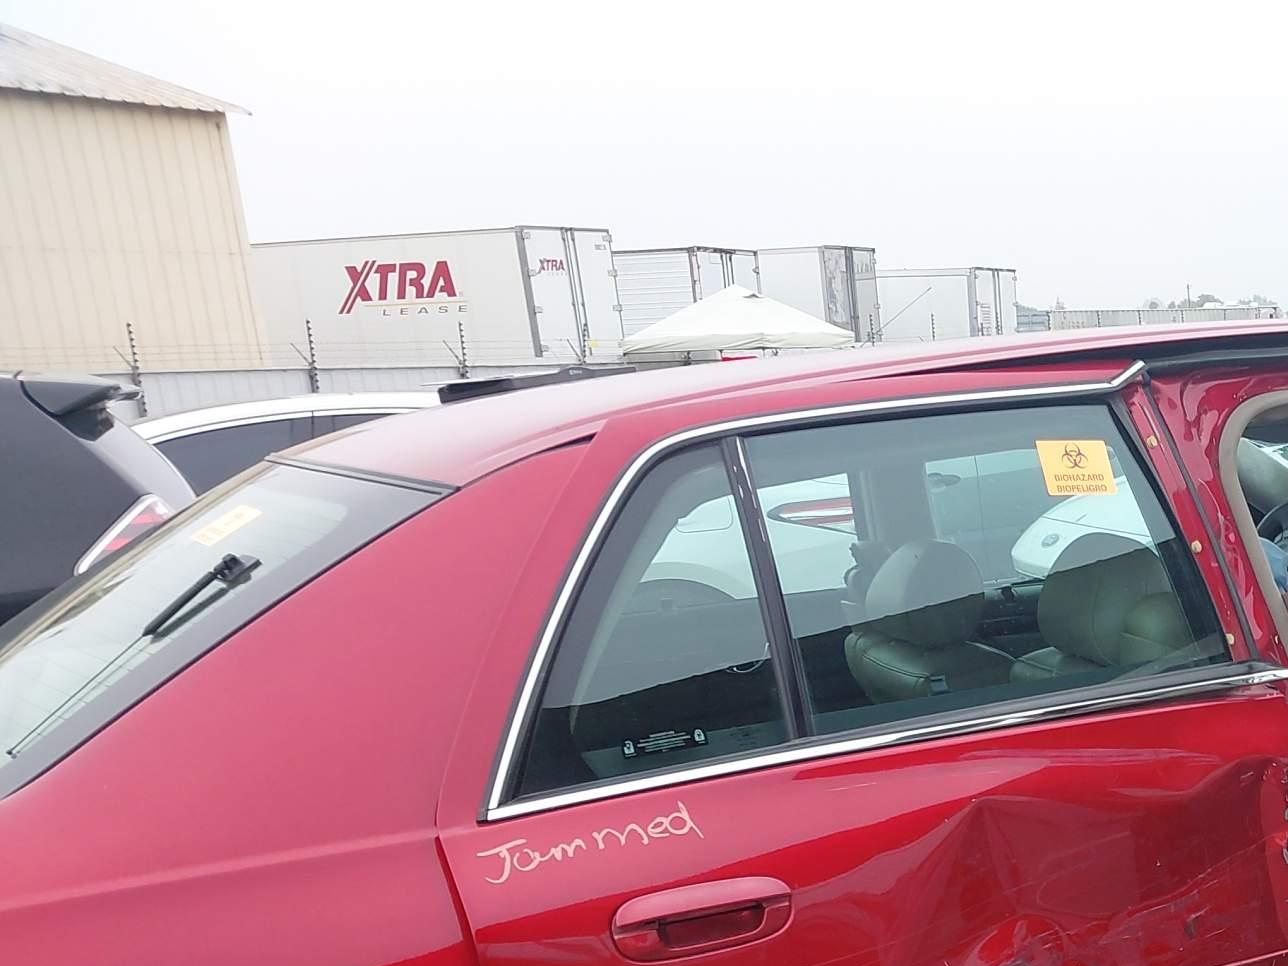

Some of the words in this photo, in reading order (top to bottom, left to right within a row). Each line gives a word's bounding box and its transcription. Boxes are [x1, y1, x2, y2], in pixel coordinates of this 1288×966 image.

[538, 258, 565, 274] XTRA
[338, 260, 457, 314] XTRA
[382, 305, 468, 317] LEASE
[1054, 473, 1104, 482] BIOHAZARD
[1056, 484, 1107, 494] BIOPELIGRO
